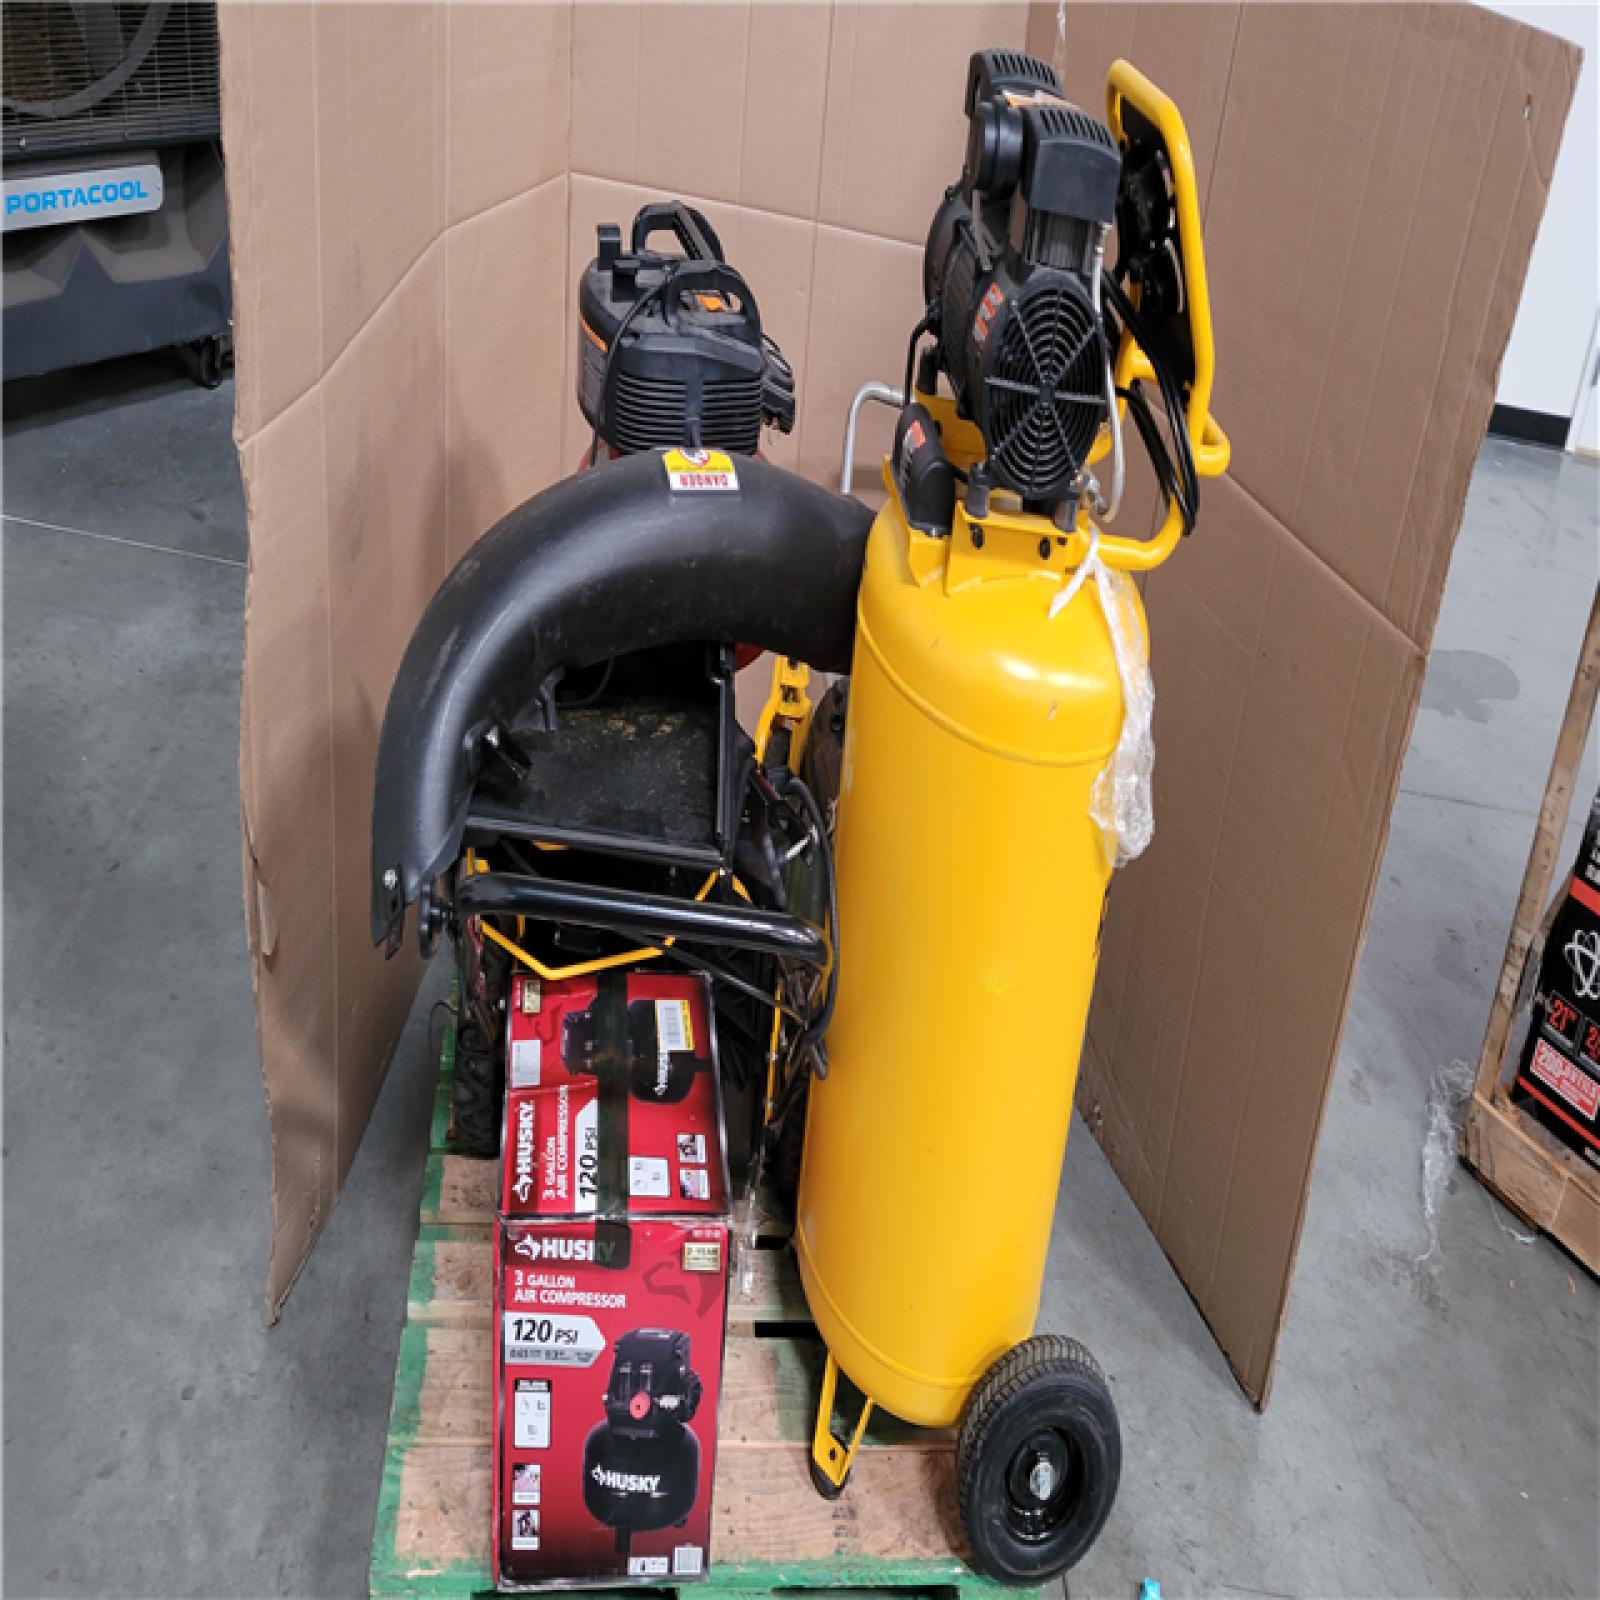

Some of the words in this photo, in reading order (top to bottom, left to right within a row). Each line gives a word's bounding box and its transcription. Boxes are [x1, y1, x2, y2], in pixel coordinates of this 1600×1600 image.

[6, 180, 148, 215] PORTACOOL
[518, 1101, 533, 1174] HUSKY
[557, 1085, 569, 1171] COMPRESSOR
[585, 1127, 598, 1150] PSI
[545, 1137, 556, 1186] GALLON
[557, 1174, 568, 1199] AIR
[580, 1155, 598, 1198] 120
[514, 1269, 524, 1286] 3
[527, 1274, 576, 1288] GALLON
[514, 1289, 537, 1303] AIR
[539, 1290, 626, 1308] COMPRESSOR
[512, 1318, 553, 1343] 120
[554, 1330, 578, 1345] PSI
[606, 1469, 660, 1492] HUSKY
